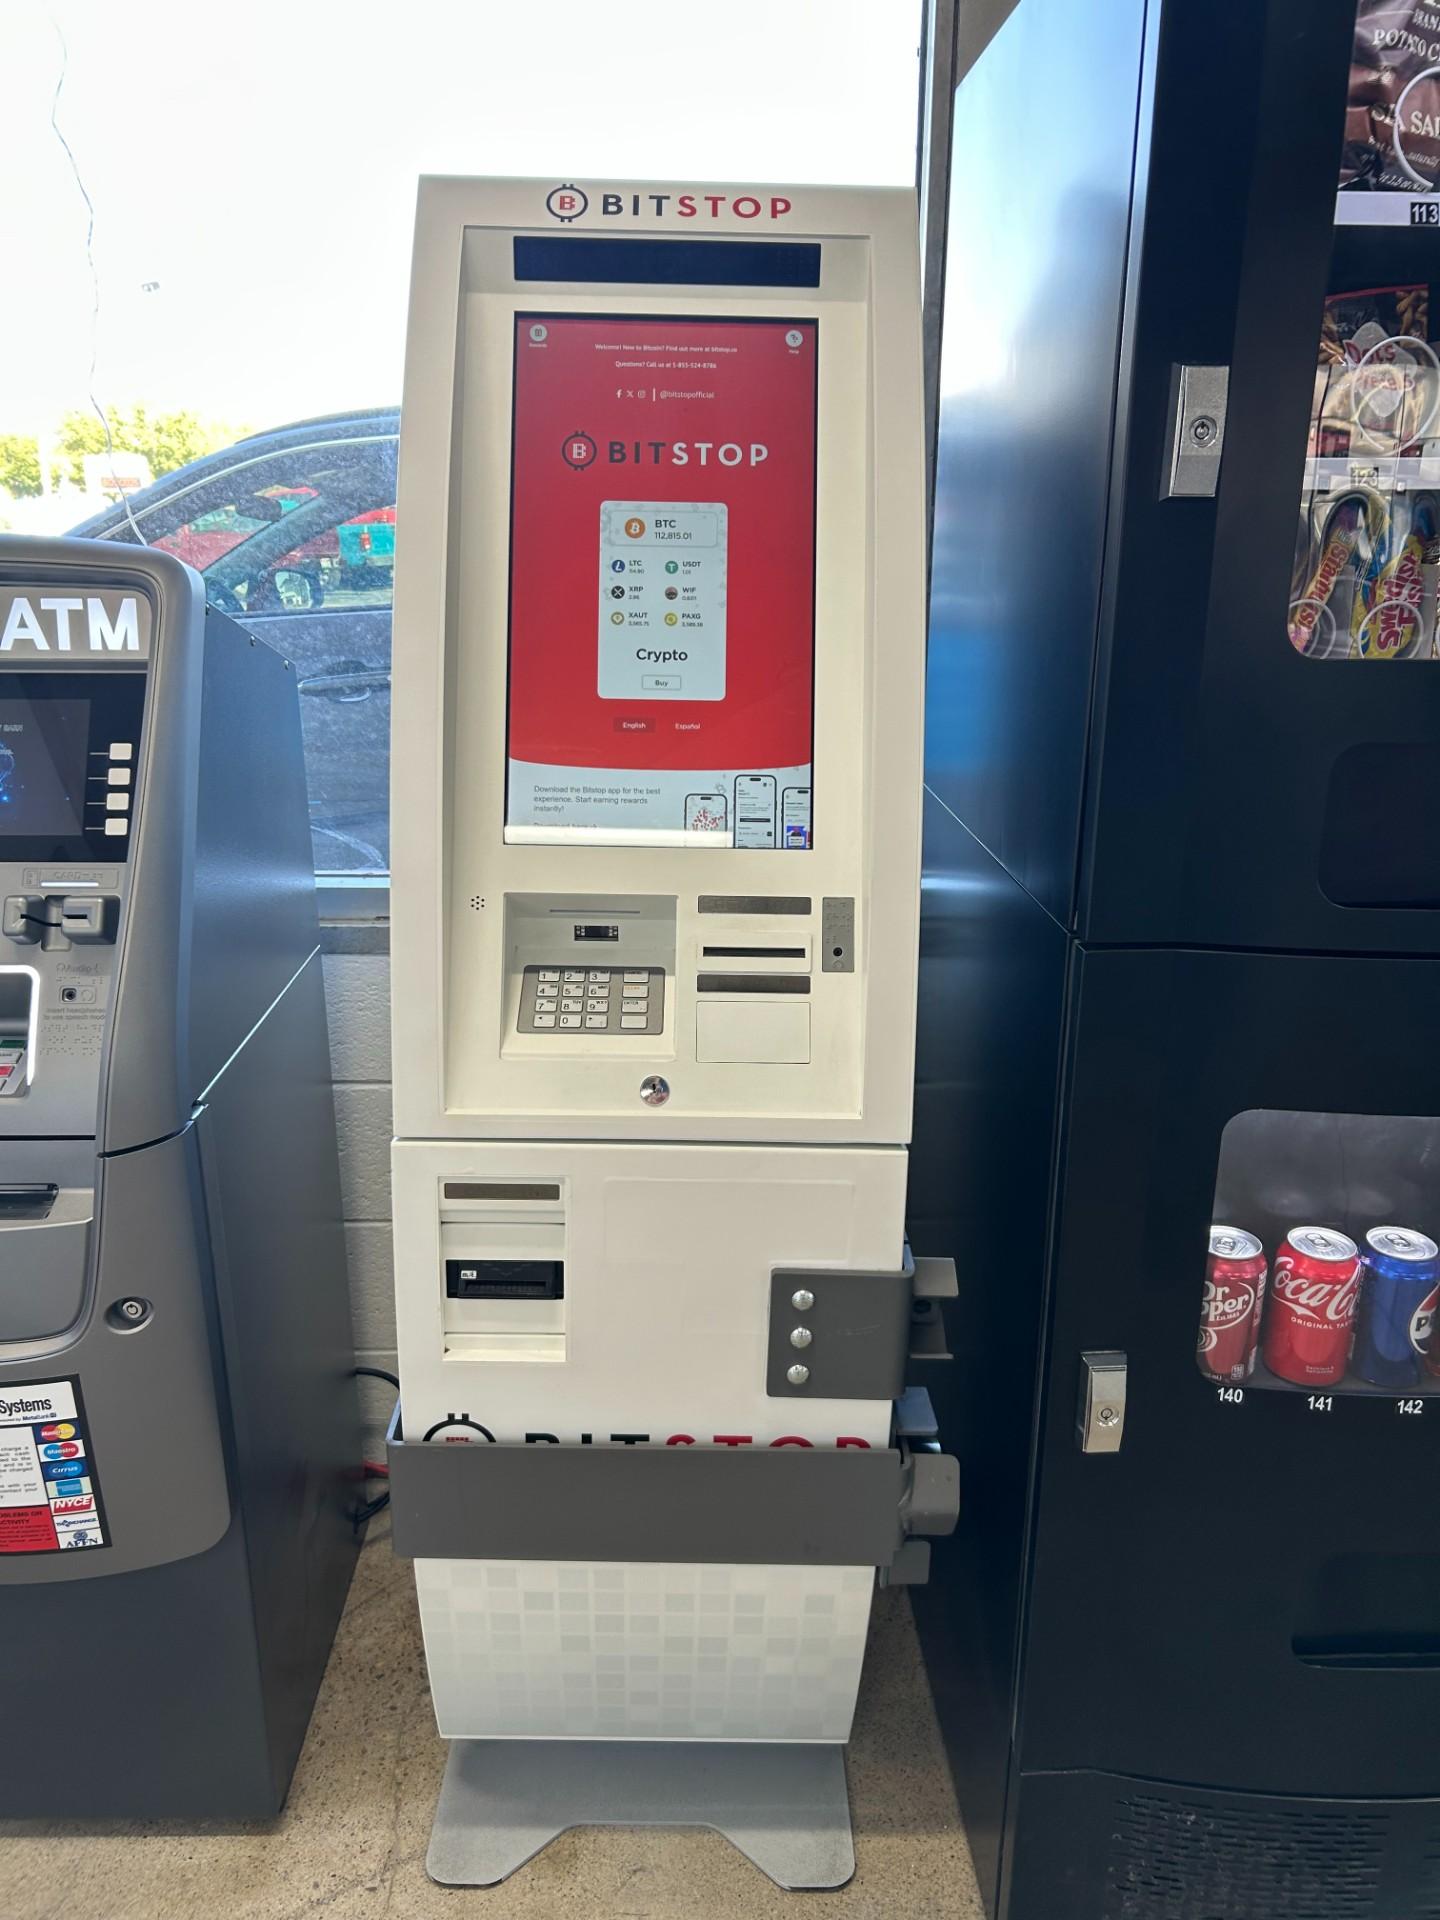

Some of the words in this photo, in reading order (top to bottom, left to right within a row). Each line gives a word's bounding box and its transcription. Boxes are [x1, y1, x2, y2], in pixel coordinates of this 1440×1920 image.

[1372, 28, 1427, 57] POTATO
[1427, 43, 1440, 61] C
[602, 194, 791, 218] BITSTOP
[1412, 204, 1438, 223] 113
[615, 360, 646, 369] Questions?
[660, 390, 715, 400] @bitstopofficial
[608, 441, 769, 466] BITSTOP
[1353, 467, 1378, 488] 123
[655, 519, 677, 528] BTC
[655, 532, 692, 540] 112,815.01
[1377, 552, 1418, 650] Swedish
[0, 598, 140, 651] ATM
[636, 648, 688, 663] Crypto
[655, 679, 668, 687] Buy
[622, 721, 647, 730] English
[674, 721, 701, 730] Español
[534, 785, 569, 793] Download
[569, 785, 581, 793] the
[582, 786, 607, 795] Bitstop
[607, 787, 620, 795] app
[622, 786, 631, 794] for
[633, 786, 644, 795] the
[646, 787, 661, 795] best
[575, 795, 592, 803] Start
[593, 797, 619, 805] earning
[620, 797, 648, 805] rewards
[591, 973, 598, 981] 3
[539, 987, 545, 995] 4
[563, 1003, 569, 1011] 8
[589, 1003, 596, 1011] 9
[1290, 1316, 1333, 1329] ORIGINAL
[1217, 1387, 1244, 1403] 140
[0, 1399, 52, 1416] Systems
[1308, 1395, 1333, 1411] 141
[1397, 1400, 1424, 1414] 142
[47, 1447, 76, 1455] Maestro
[52, 1465, 78, 1474] Cirrus
[55, 1497, 91, 1509] NYCE
[66, 1537, 98, 1548] AFFN
